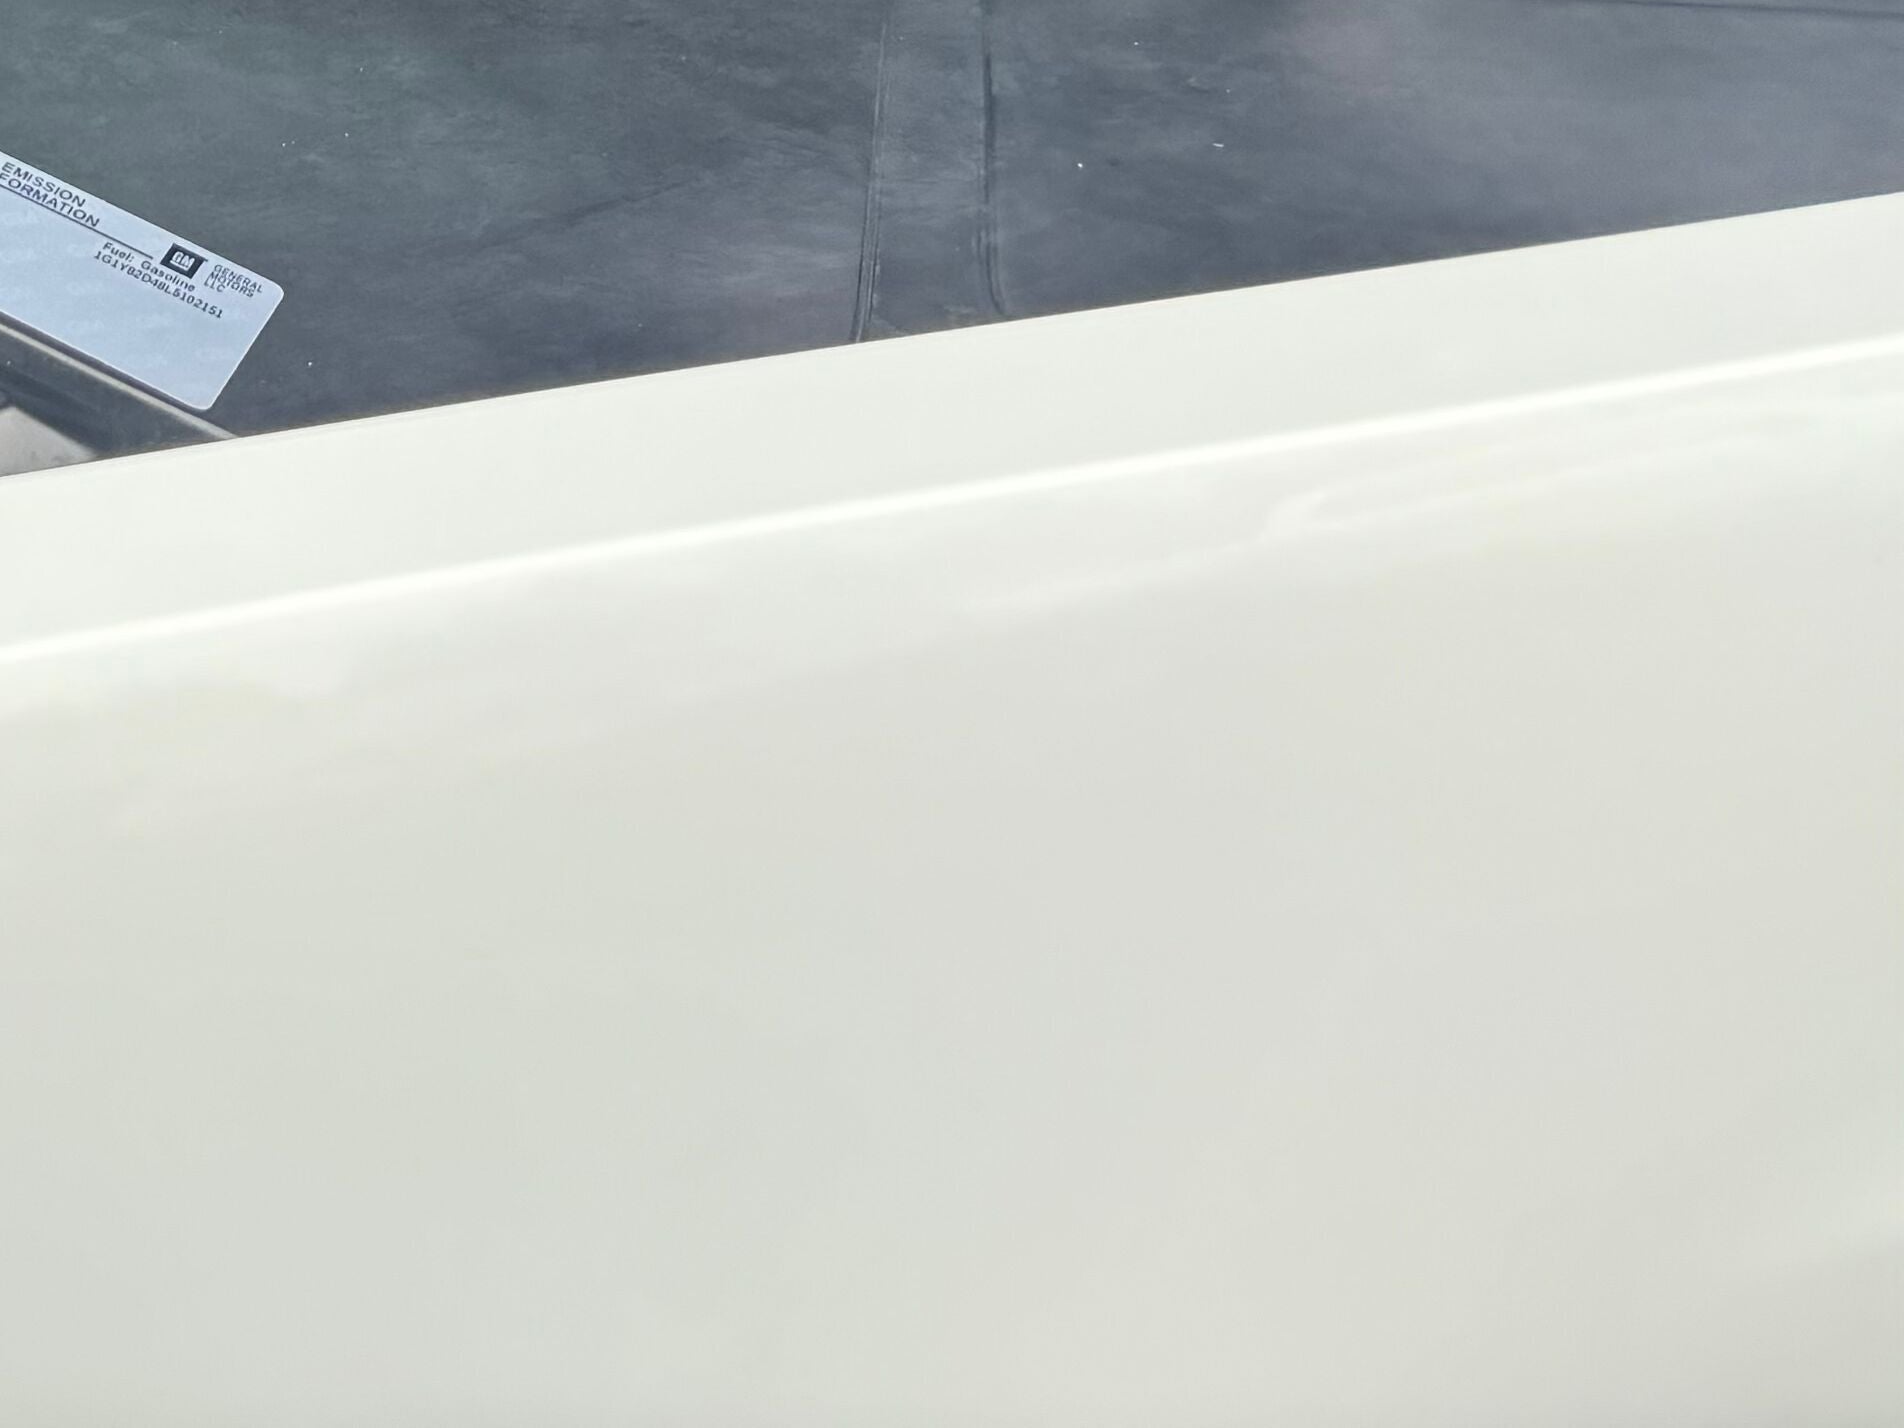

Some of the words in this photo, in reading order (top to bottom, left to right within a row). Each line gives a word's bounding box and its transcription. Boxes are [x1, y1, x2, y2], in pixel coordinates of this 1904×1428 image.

[0, 161, 87, 207] EMISSION
[101, 241, 136, 263] Fuel:
[139, 259, 197, 292] Gasoline
[212, 263, 265, 293] GENERAL
[202, 276, 227, 293] LLC
[207, 270, 256, 298] MOTORS
